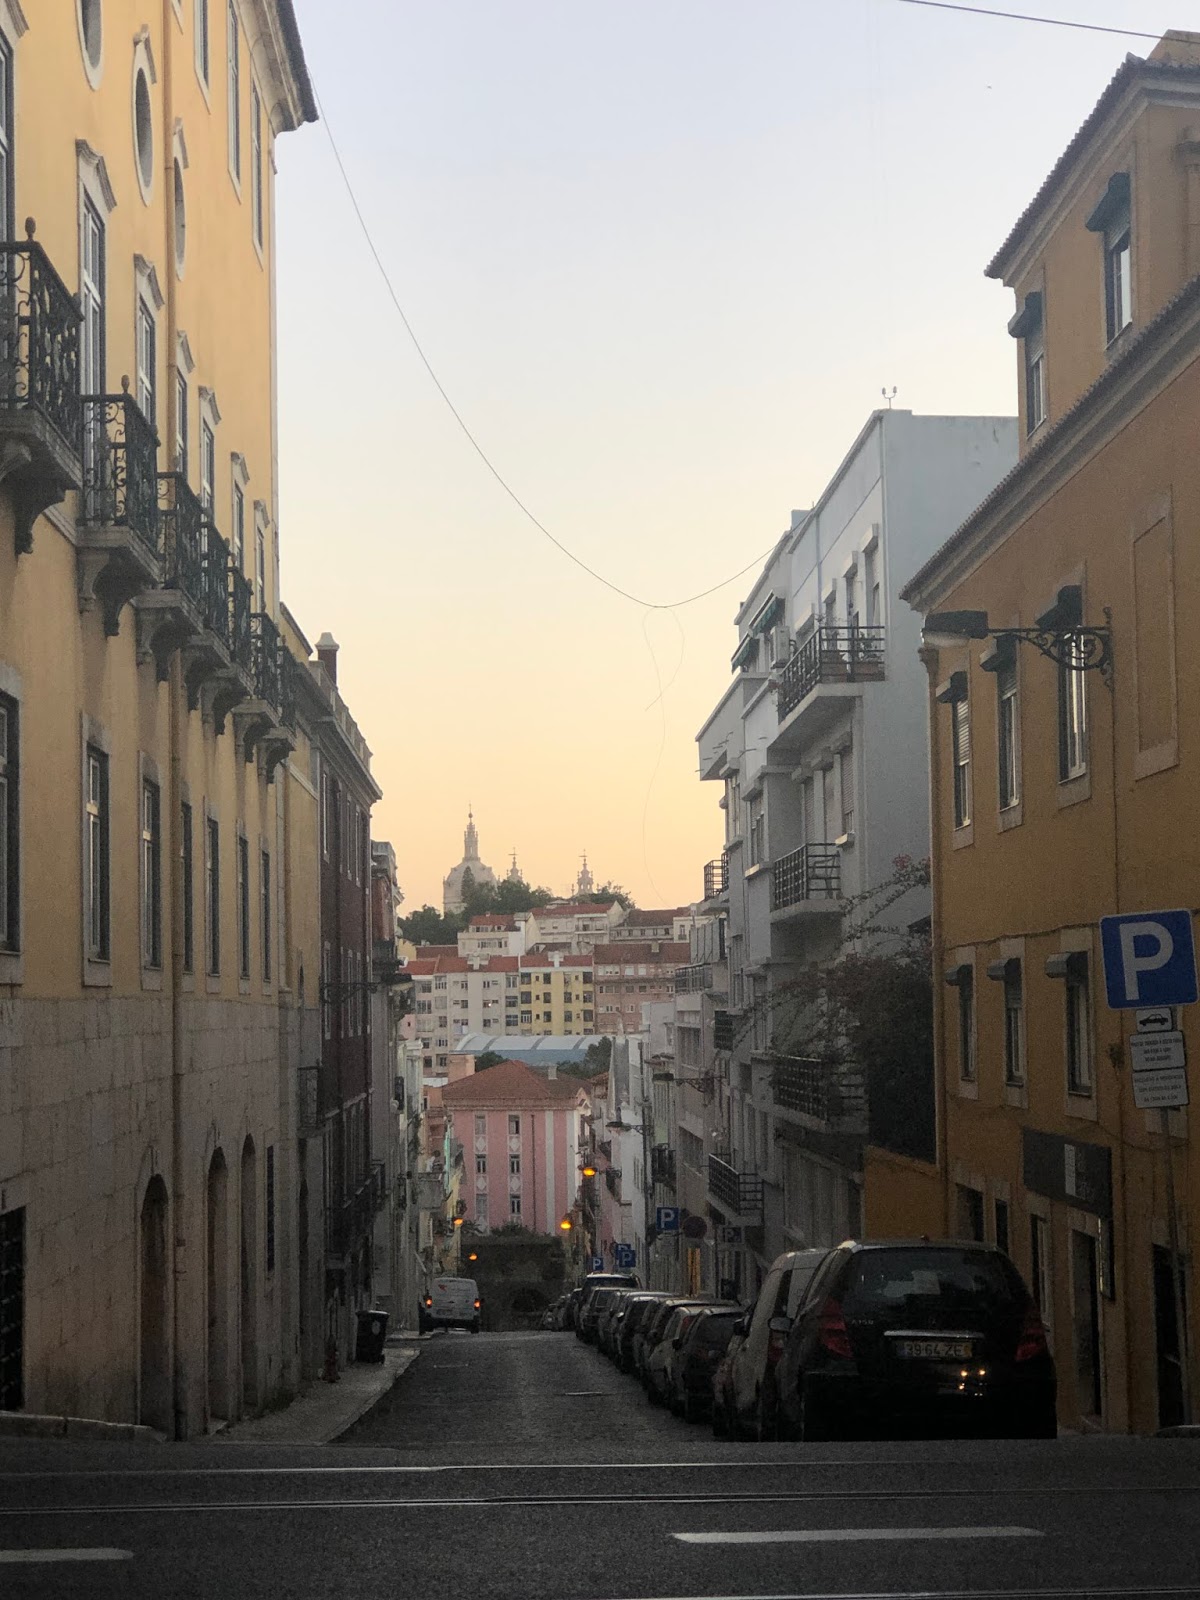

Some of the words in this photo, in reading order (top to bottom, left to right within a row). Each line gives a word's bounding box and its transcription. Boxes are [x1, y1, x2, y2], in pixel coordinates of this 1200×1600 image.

[1119, 921, 1174, 1001] P
[661, 1209, 675, 1228] P
[725, 1229, 734, 1242] P
[592, 1258, 601, 1270] P
[622, 1251, 632, 1266] P
